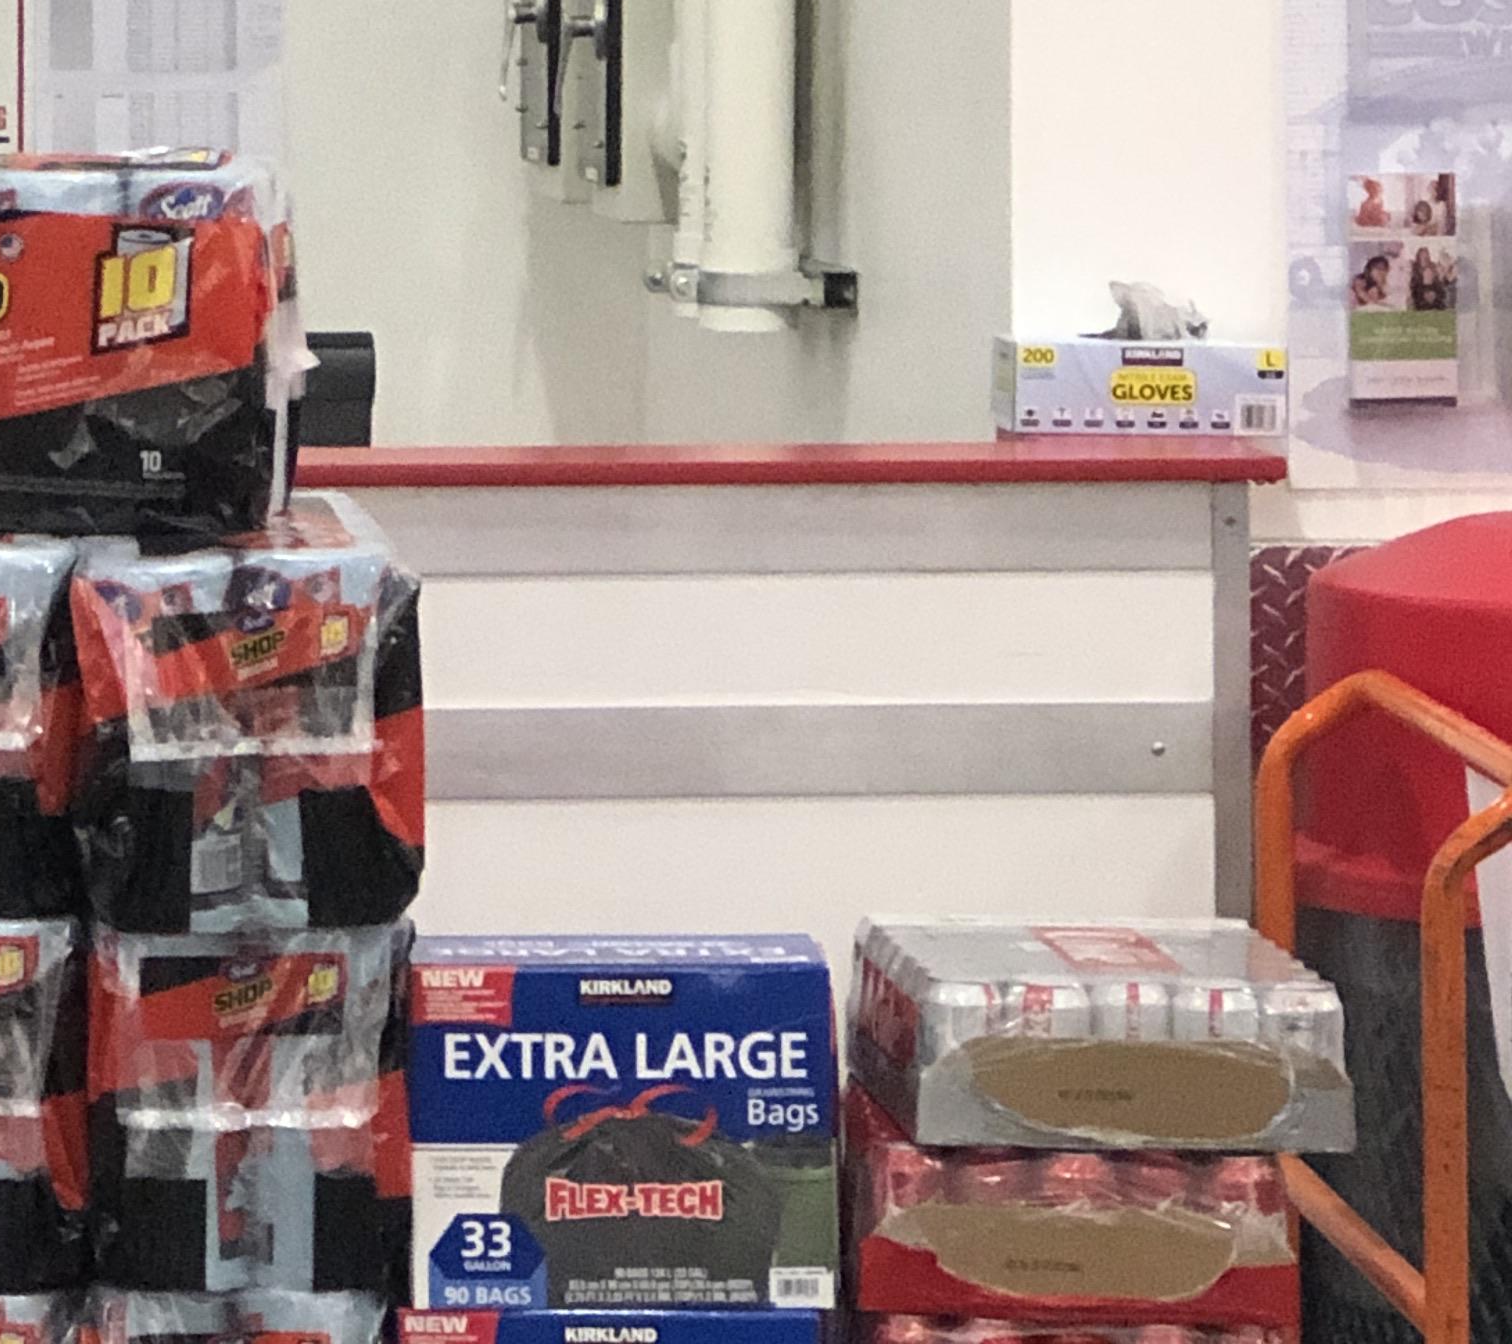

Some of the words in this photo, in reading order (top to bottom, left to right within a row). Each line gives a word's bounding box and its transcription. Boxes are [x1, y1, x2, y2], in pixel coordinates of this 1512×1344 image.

[98, 244, 178, 318] 10
[97, 312, 171, 348] PACK
[1022, 348, 1055, 364] 200
[1111, 383, 1194, 402] GLOVES
[230, 629, 286, 662] SHOP
[214, 978, 273, 1012] SHOP
[421, 968, 486, 989] NEW
[579, 978, 673, 996] KIRKLAND
[443, 1032, 619, 1081] EXTRA
[636, 1031, 808, 1081] LARGE
[747, 1098, 820, 1132] Bags
[545, 1177, 723, 1221] FLEX-TECH
[460, 1220, 512, 1259] 33
[444, 1286, 470, 1305] 90
[475, 1286, 532, 1305] BAGS
[403, 1314, 468, 1334] NEW
[563, 1326, 659, 1344] KIRKLAND
